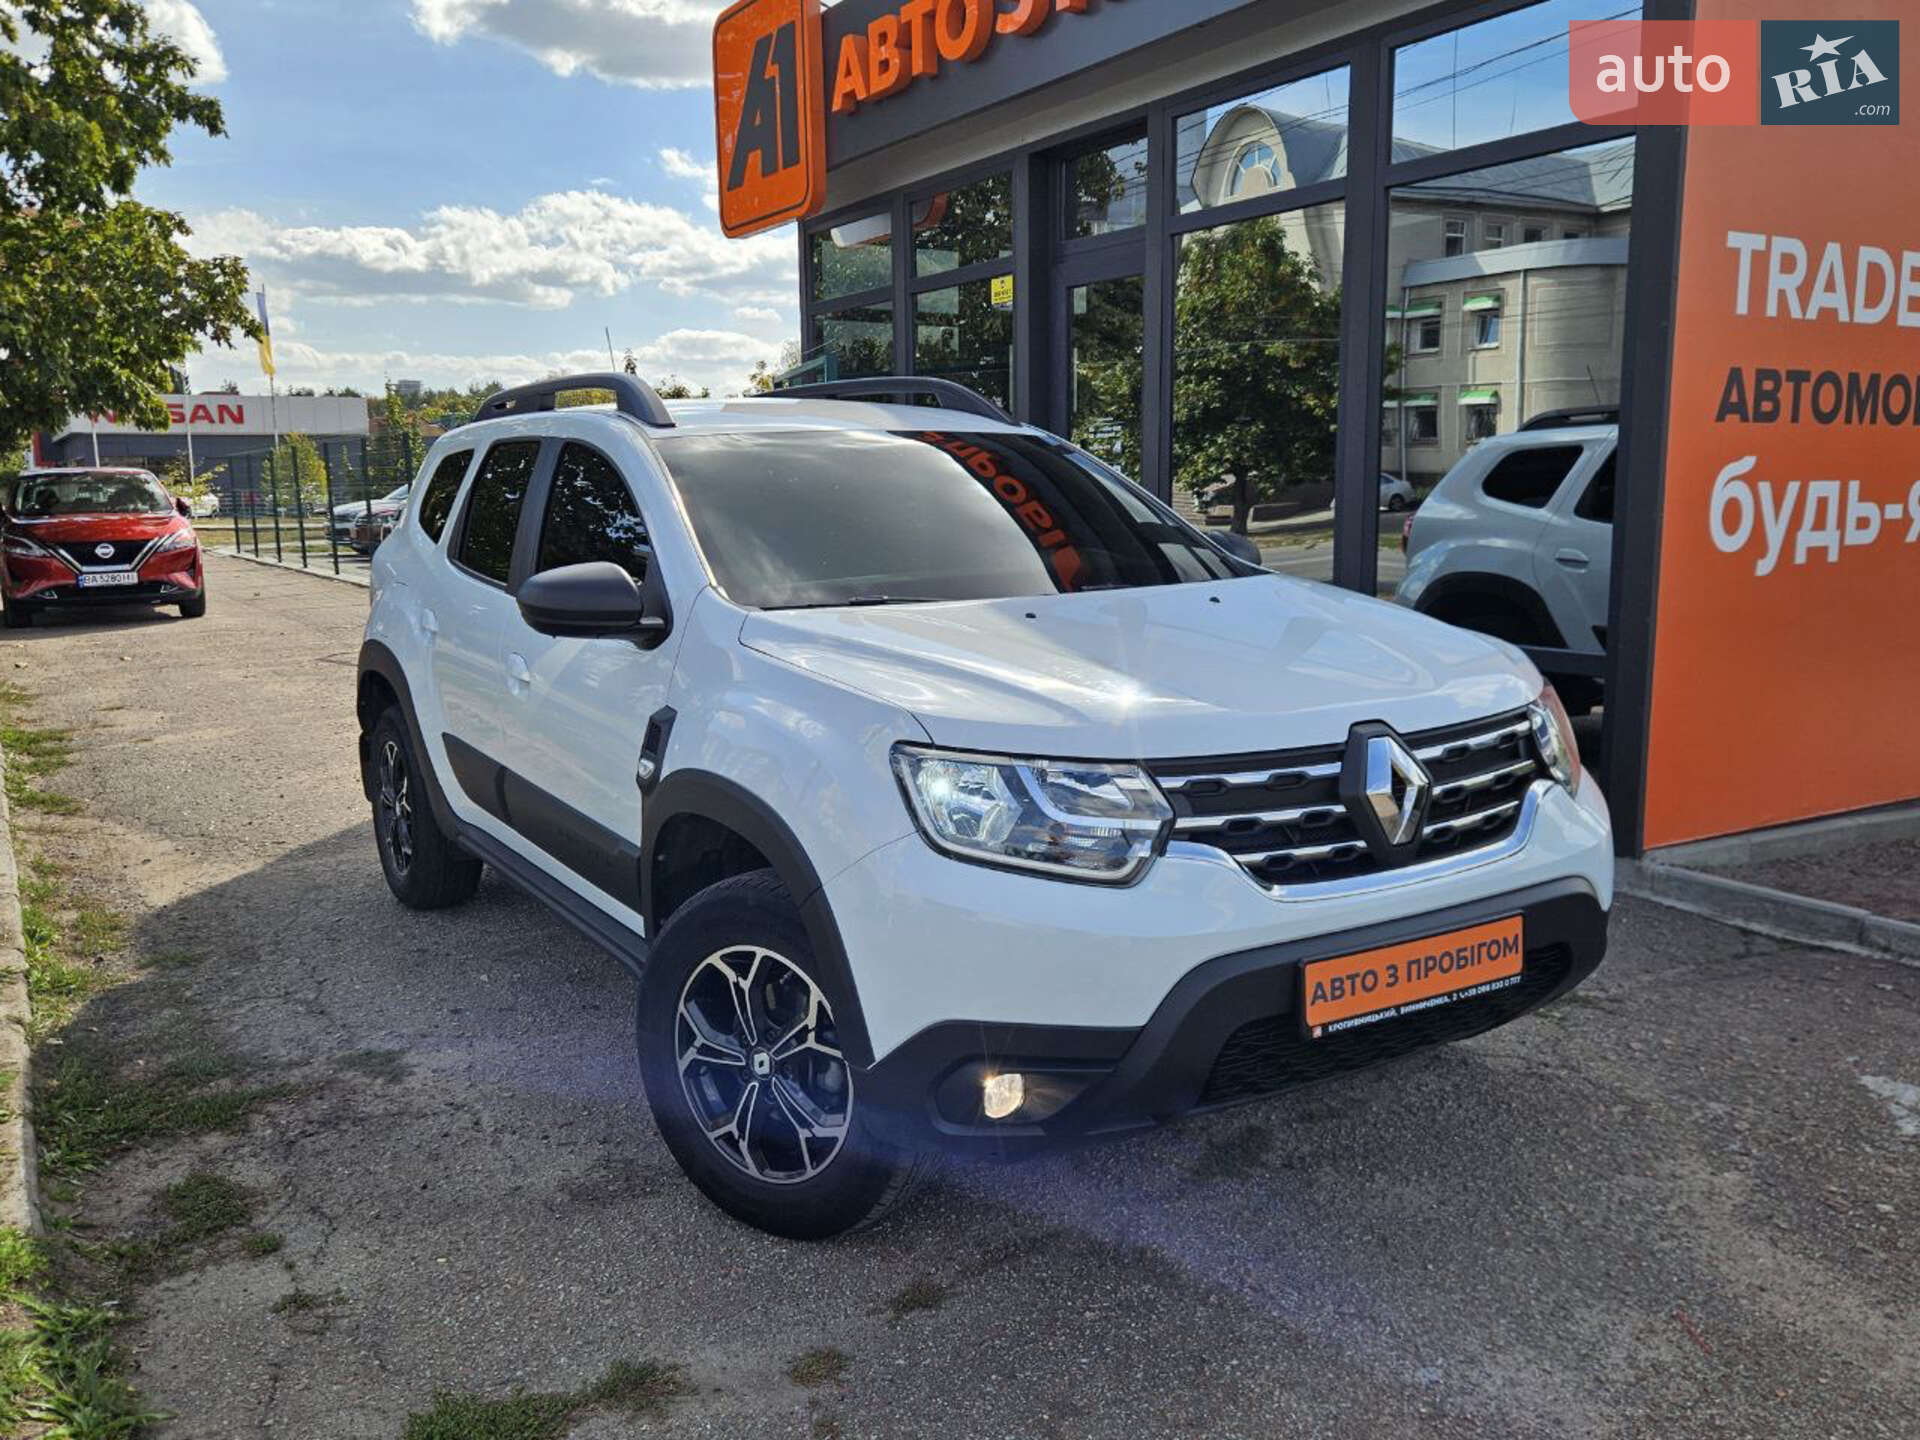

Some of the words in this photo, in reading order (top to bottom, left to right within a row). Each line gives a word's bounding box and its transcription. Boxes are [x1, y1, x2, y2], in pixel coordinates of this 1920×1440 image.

[727, 20, 800, 192] A1
[832, 0, 992, 114] АВТО
[1726, 230, 1920, 328] TRADE
[1310, 969, 1378, 1006] АВТО
[1406, 933, 1519, 983] ПРОБІГОМ
